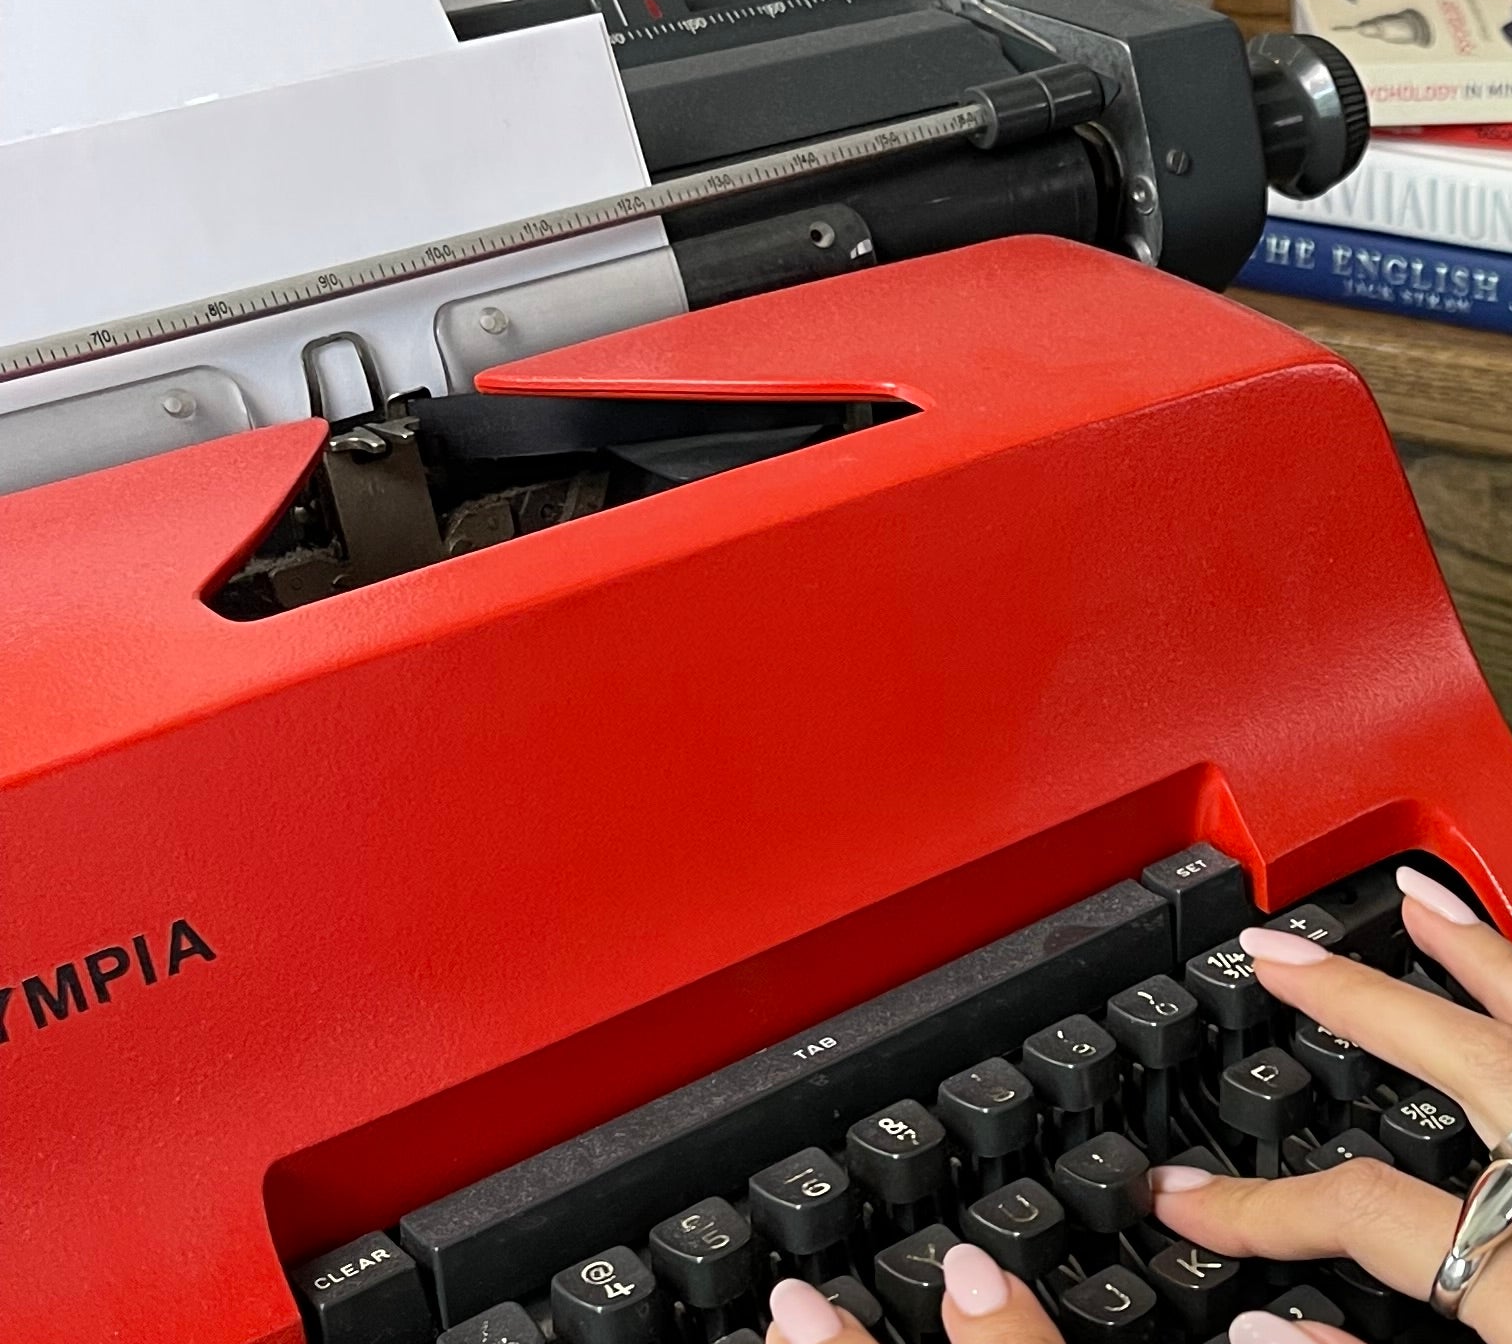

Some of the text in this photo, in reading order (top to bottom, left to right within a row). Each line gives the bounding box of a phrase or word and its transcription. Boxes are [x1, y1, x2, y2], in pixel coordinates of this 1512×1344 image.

[1368, 83, 1458, 102] YCHOLOGY
[1464, 82, 1484, 99] IN
[1261, 233, 1315, 270] HE
[1332, 244, 1499, 303] ENGLISH
[90, 330, 111, 346] 70
[207, 301, 228, 317] 80
[318, 273, 338, 289] 90
[1176, 859, 1207, 878] SET
[1207, 952, 1245, 969] 1/4
[793, 1036, 837, 1061] TAB
[1401, 1103, 1438, 1121] 5/8
[1420, 1114, 1456, 1130] 7/8
[998, 1194, 1039, 1223] U
[314, 1248, 391, 1291] CLEAR
[580, 1260, 614, 1286] @
[1176, 1249, 1222, 1278] K
[605, 1279, 635, 1301] 4
[1103, 1282, 1131, 1312] J
